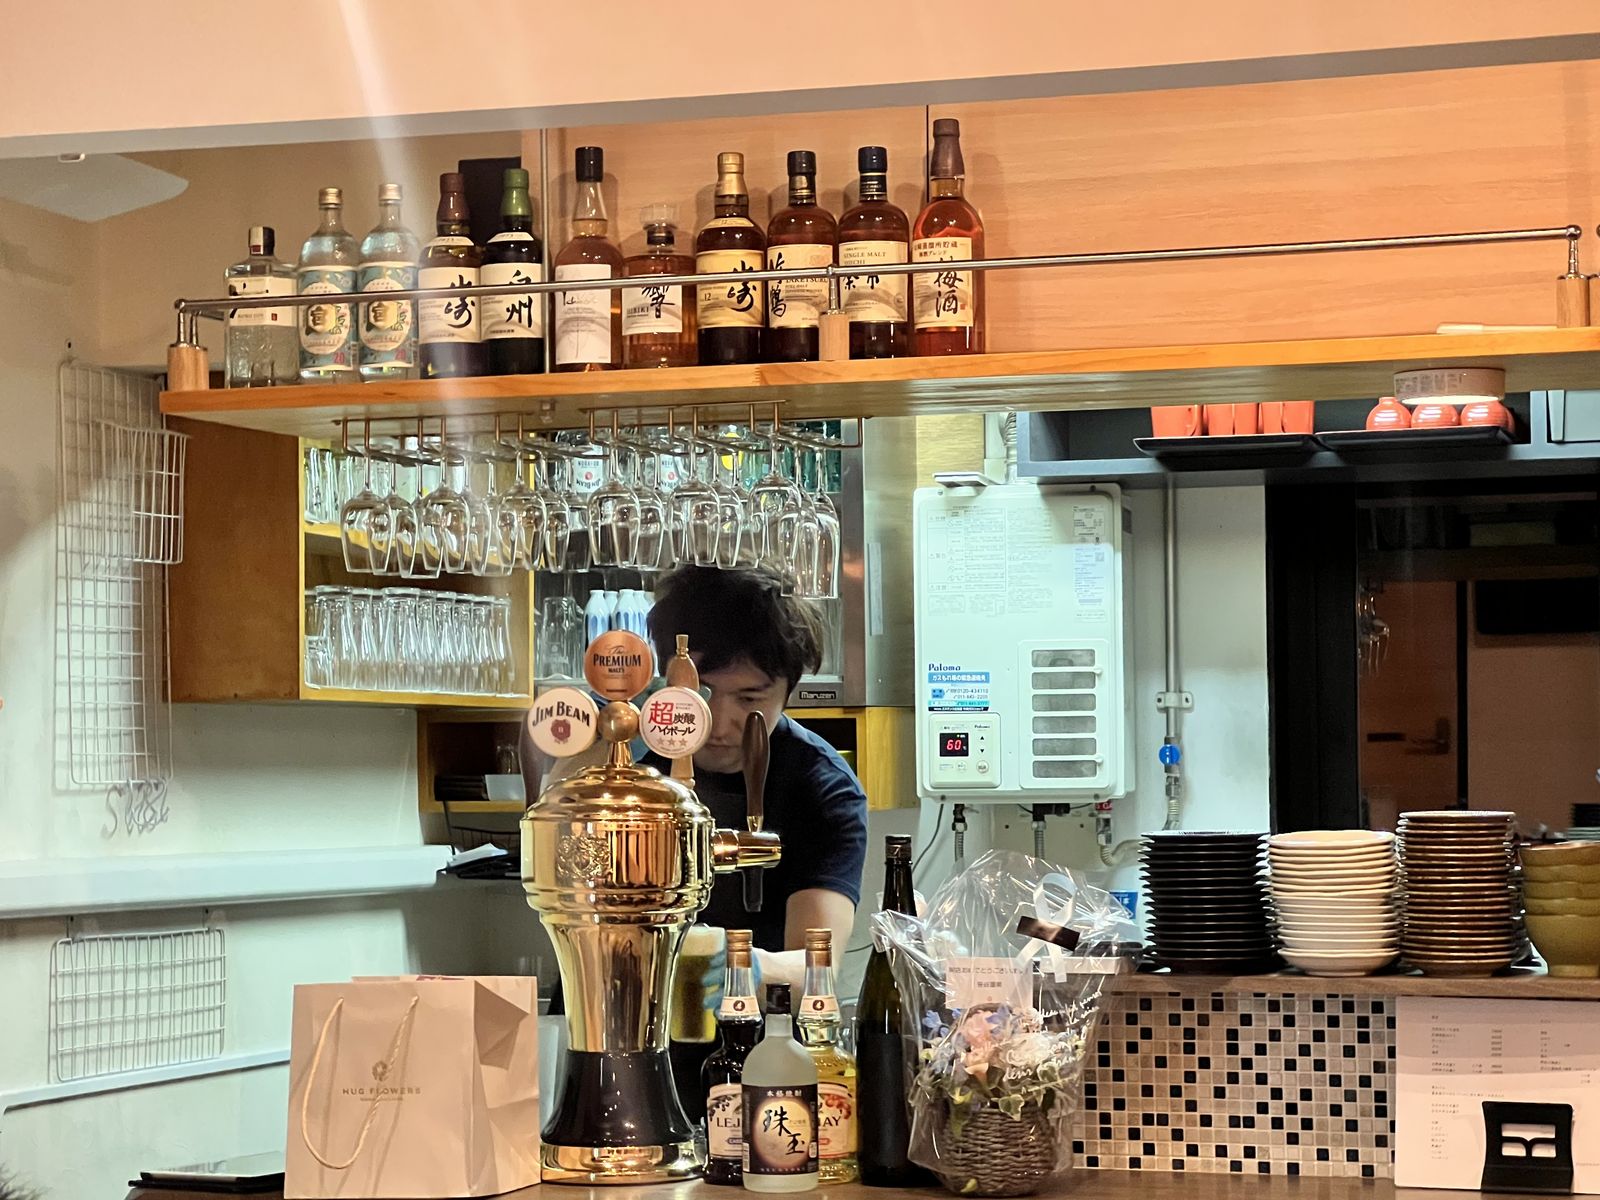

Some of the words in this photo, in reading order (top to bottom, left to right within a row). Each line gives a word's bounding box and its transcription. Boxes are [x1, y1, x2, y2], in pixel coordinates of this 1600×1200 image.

[934, 255, 964, 318] 梅酒
[704, 292, 712, 301] 12
[592, 653, 642, 667] PREMIUM
[928, 663, 961, 671] Paloma
[532, 703, 554, 728] JIM
[556, 700, 591, 728] BEAM
[650, 724, 697, 738] ハイボール
[946, 739, 962, 751] 60
[342, 1087, 365, 1095] HUG
[369, 1086, 422, 1095] FLOWERS
[762, 1105, 805, 1156] 珠玉
